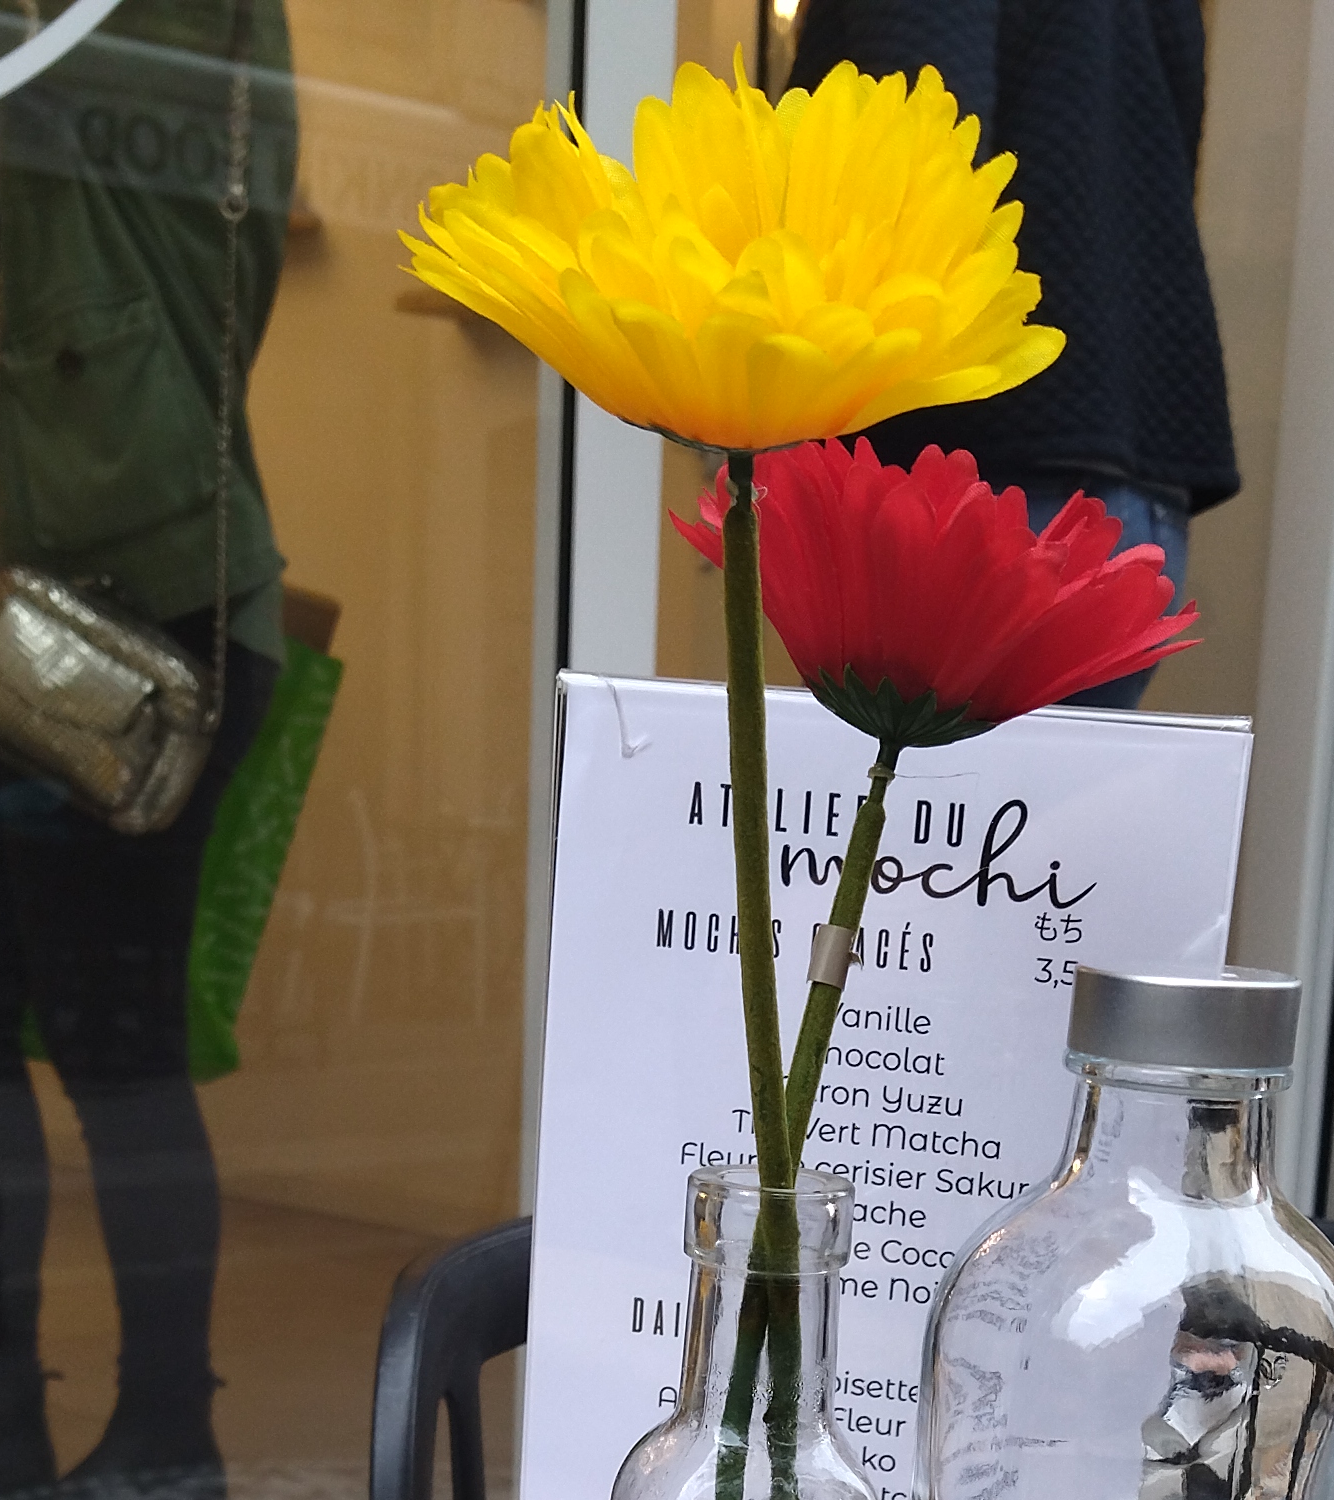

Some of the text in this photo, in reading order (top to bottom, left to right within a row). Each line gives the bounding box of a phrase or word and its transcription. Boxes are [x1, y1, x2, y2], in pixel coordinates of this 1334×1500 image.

[688, 780, 966, 847] ATLIE DU
[780, 798, 1098, 909] mochi
[655, 908, 782, 959] MOCHS
[811, 921, 935, 973] ACÉS
[1034, 911, 1083, 944] もち
[880, 1084, 963, 1118] Yuzu
[871, 1121, 1002, 1161] Matcha
[934, 1168, 1030, 1200] Sakur
[852, 1200, 927, 1228] ache
[631, 1296, 681, 1338] DAI
[834, 1370, 918, 1404] isette
